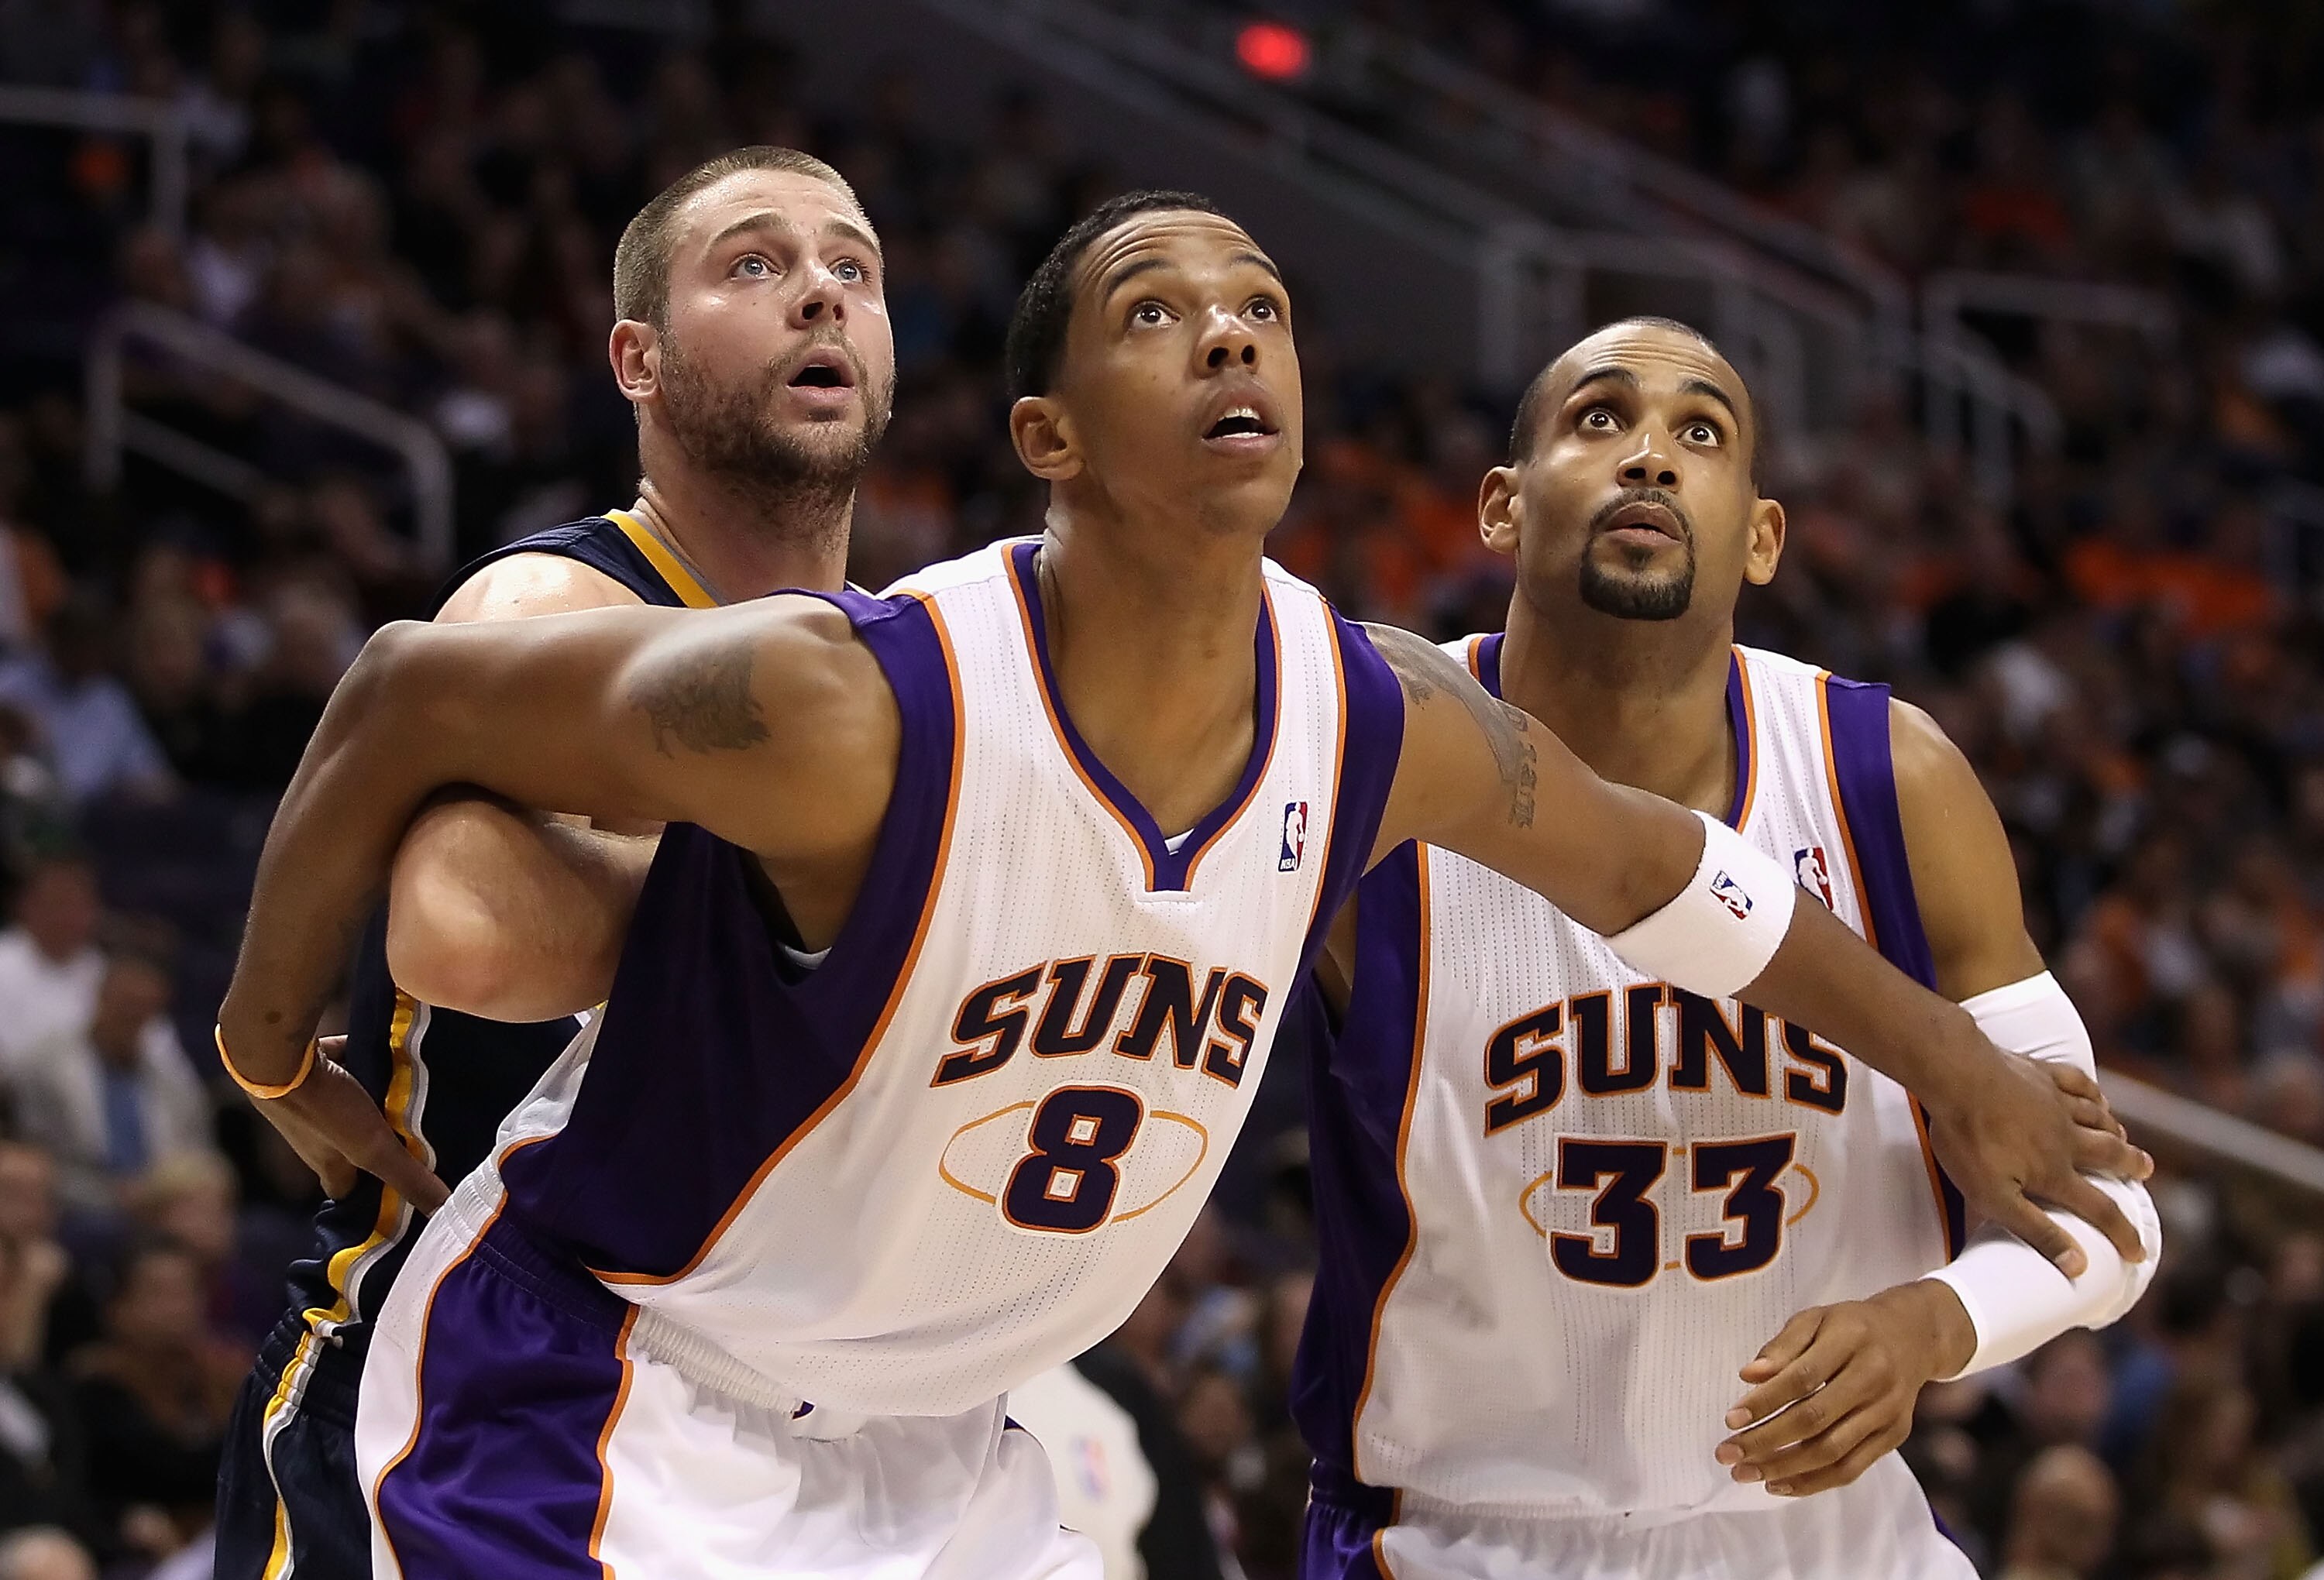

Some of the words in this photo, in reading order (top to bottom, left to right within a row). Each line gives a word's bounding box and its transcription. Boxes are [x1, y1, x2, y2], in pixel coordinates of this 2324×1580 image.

[930, 952, 1269, 1088] SUNS
[1483, 981, 1848, 1139] SUNS
[1001, 1084, 1145, 1235] 8
[1550, 1132, 1796, 1288] 33
